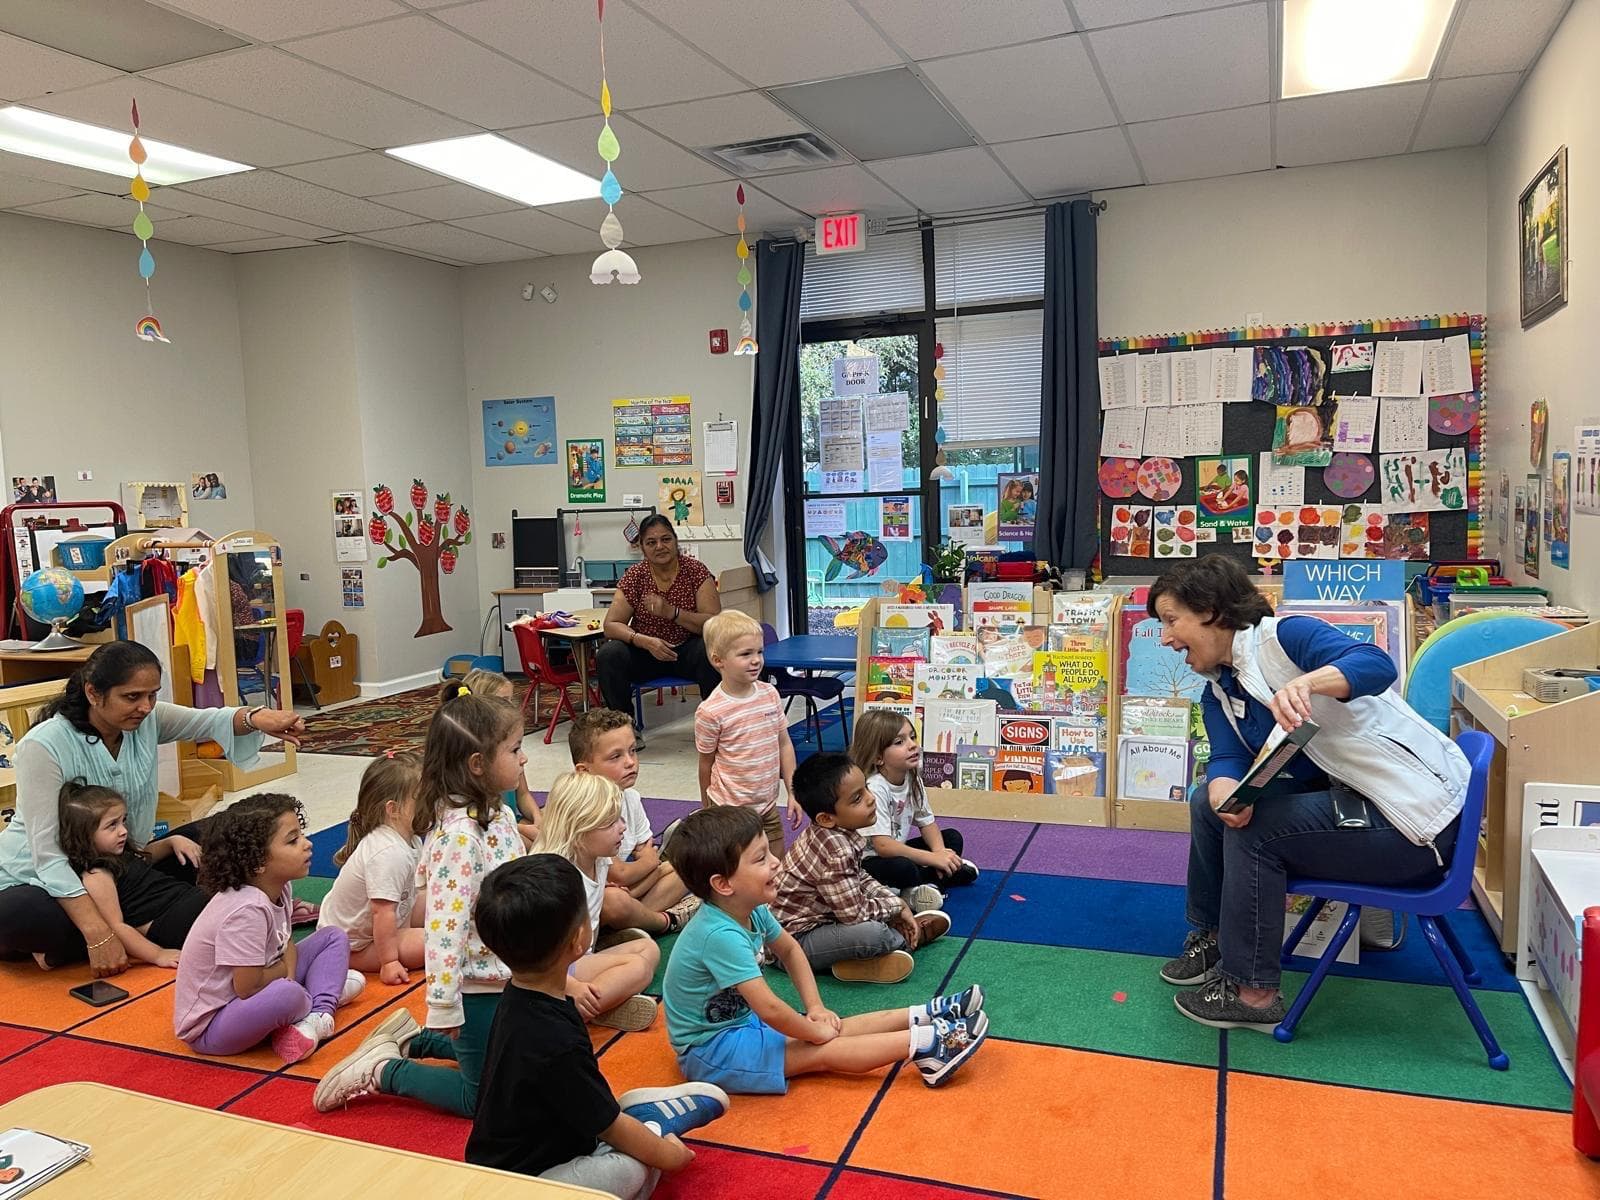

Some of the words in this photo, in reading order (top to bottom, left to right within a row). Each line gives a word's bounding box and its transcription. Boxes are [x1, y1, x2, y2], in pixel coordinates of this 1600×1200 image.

[823, 216, 858, 249] EXIT
[845, 378, 866, 386] DOOR
[593, 492, 604, 500] Play
[1200, 520, 1218, 528] Sand
[1305, 564, 1381, 582] WHICH
[1316, 584, 1366, 600] WAY
[1135, 627, 1153, 637] Fall
[1061, 668, 1088, 676] PEOPLE
[1077, 676, 1097, 684] DAY?
[1006, 726, 1044, 739] SIGNS
[1061, 729, 1082, 737] How
[1083, 728, 1094, 737] to
[1069, 736, 1086, 744] Use
[1061, 744, 1094, 753] MAPS
[1130, 746, 1141, 756] All
[1142, 744, 1168, 753] About
[1169, 748, 1182, 760] Me
[1194, 743, 1210, 754] GO
